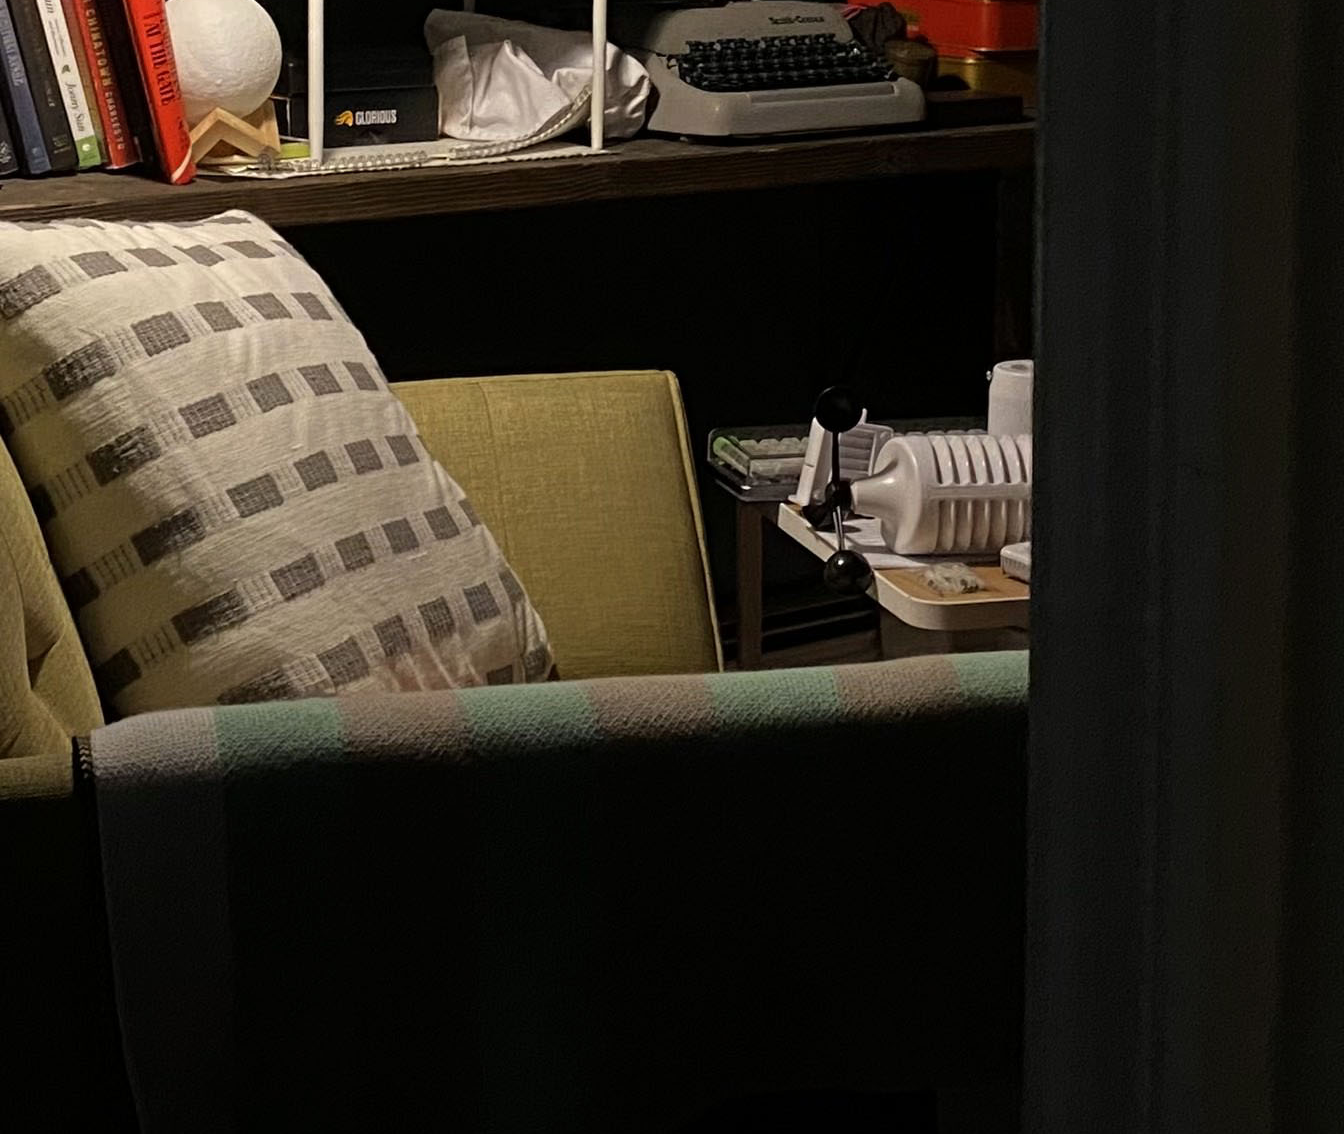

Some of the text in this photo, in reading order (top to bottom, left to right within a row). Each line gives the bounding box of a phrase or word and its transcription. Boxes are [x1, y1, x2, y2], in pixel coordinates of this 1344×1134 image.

[144, 22, 161, 39] AT
[85, 8, 113, 86] CHINATOWN
[149, 41, 168, 69] THE
[156, 70, 176, 106] GATE
[73, 113, 85, 132] Sun
[355, 109, 397, 126] GLORIOUS
